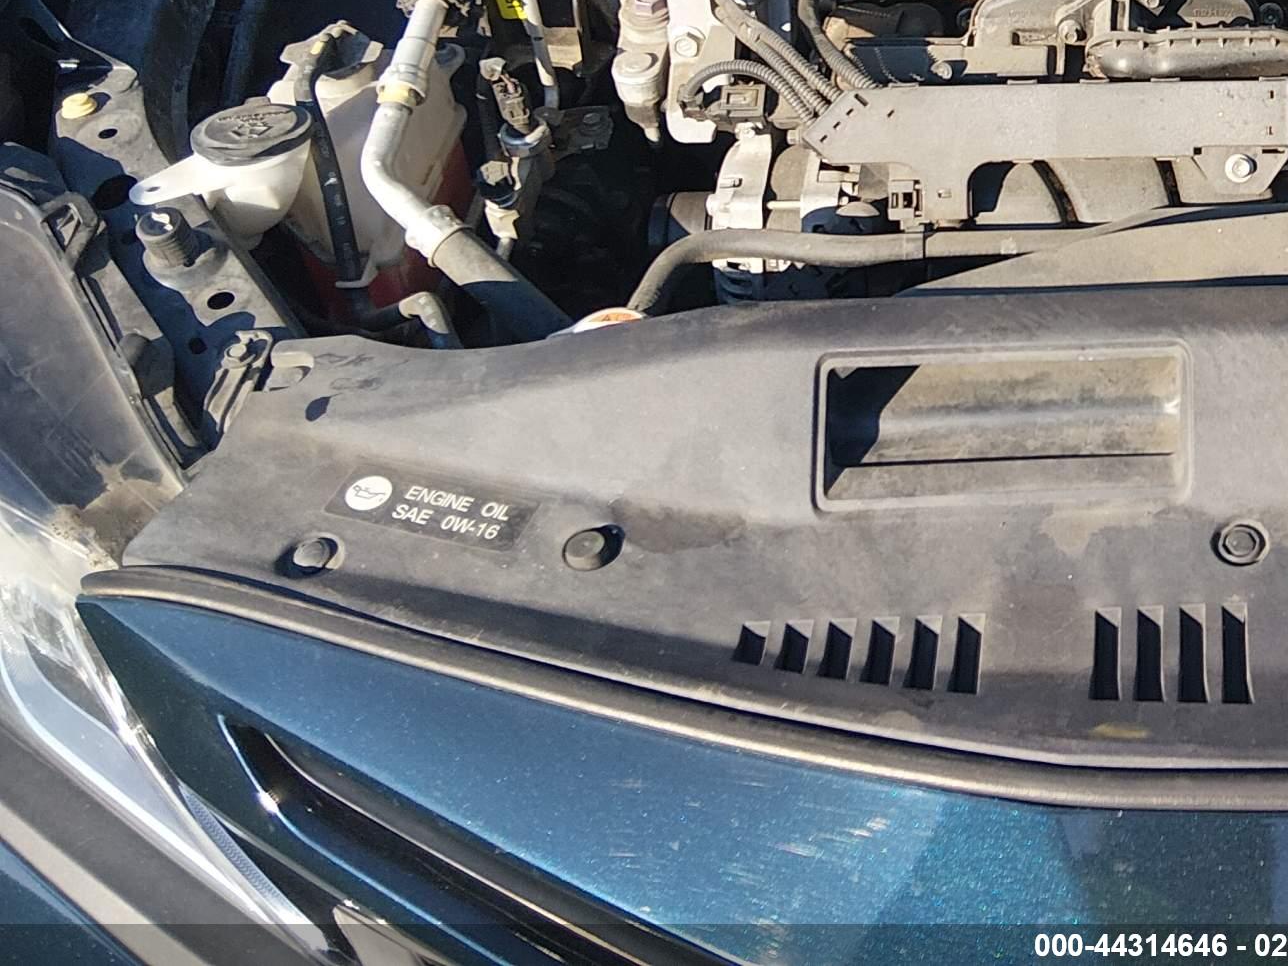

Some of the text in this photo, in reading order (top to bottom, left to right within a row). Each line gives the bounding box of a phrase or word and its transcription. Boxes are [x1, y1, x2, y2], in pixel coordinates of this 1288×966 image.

[404, 485, 510, 522] ENGINE OIL
[391, 504, 501, 540] SAE 0W-16
